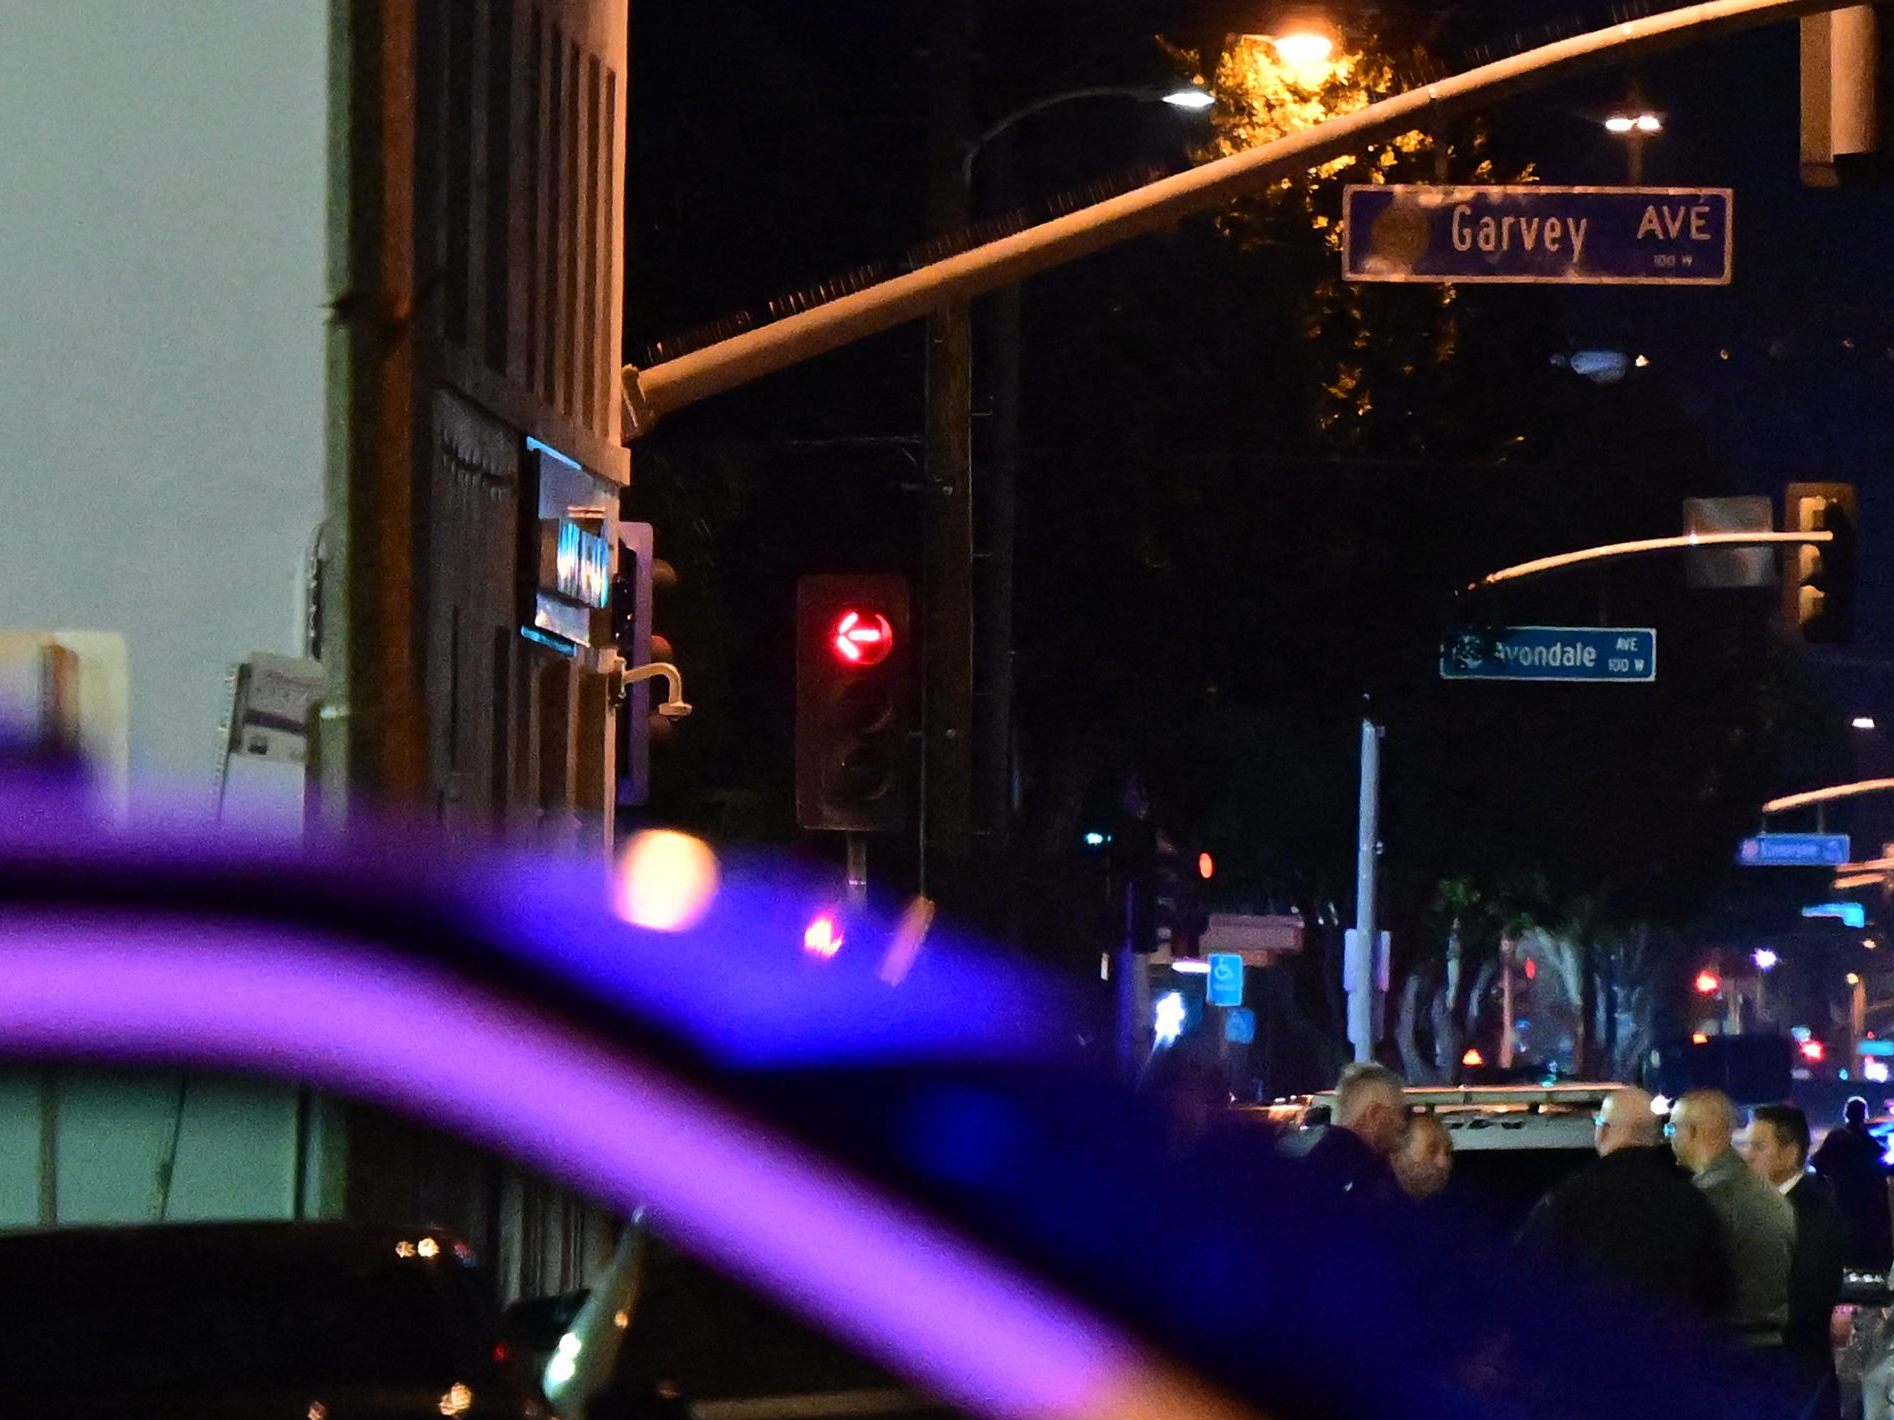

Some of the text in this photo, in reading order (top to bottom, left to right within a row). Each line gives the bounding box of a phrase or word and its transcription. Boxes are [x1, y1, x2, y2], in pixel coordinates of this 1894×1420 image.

[1451, 204, 1712, 263] Garvey AVE
[1494, 636, 1639, 668] Avondale AVE
[1633, 659, 1645, 673] W
